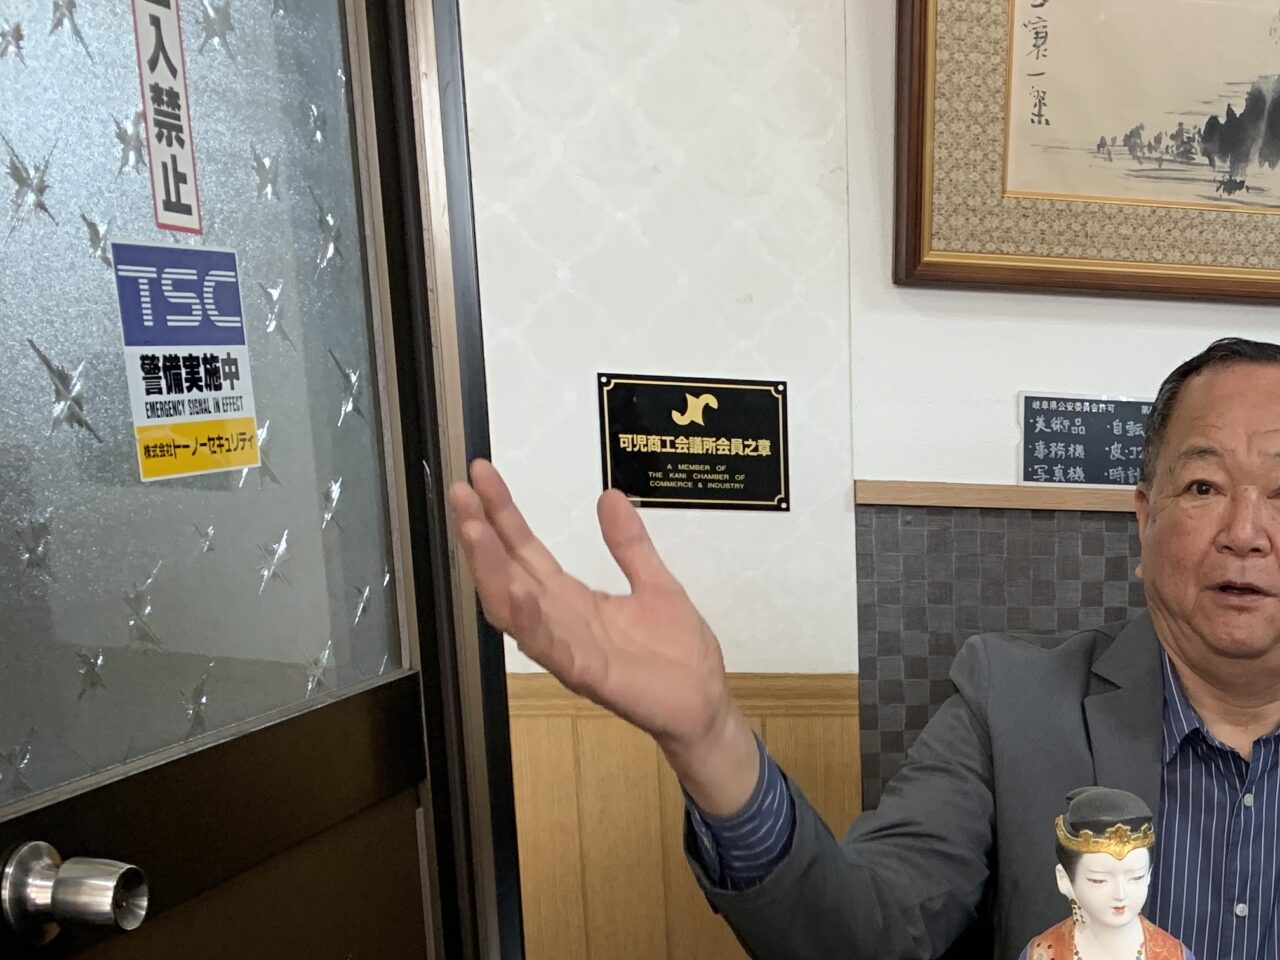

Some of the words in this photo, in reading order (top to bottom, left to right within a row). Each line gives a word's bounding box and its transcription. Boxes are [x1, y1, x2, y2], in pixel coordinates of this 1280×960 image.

[146, 0, 193, 215] 入禁止
[117, 264, 242, 326] TSC
[139, 352, 241, 396] 警備実施中
[145, 400, 186, 419] EMERGENCY
[188, 398, 212, 415] SIGNAL
[213, 397, 221, 413] IN
[222, 395, 244, 412] EFFECT
[1032, 400, 1115, 414] 岐阜県公安委員会許可
[143, 431, 255, 459] 株式会社トーノーセキュリティ
[618, 433, 772, 457] 可児商工会議所会員之章
[649, 480, 694, 489] COMMERCE
